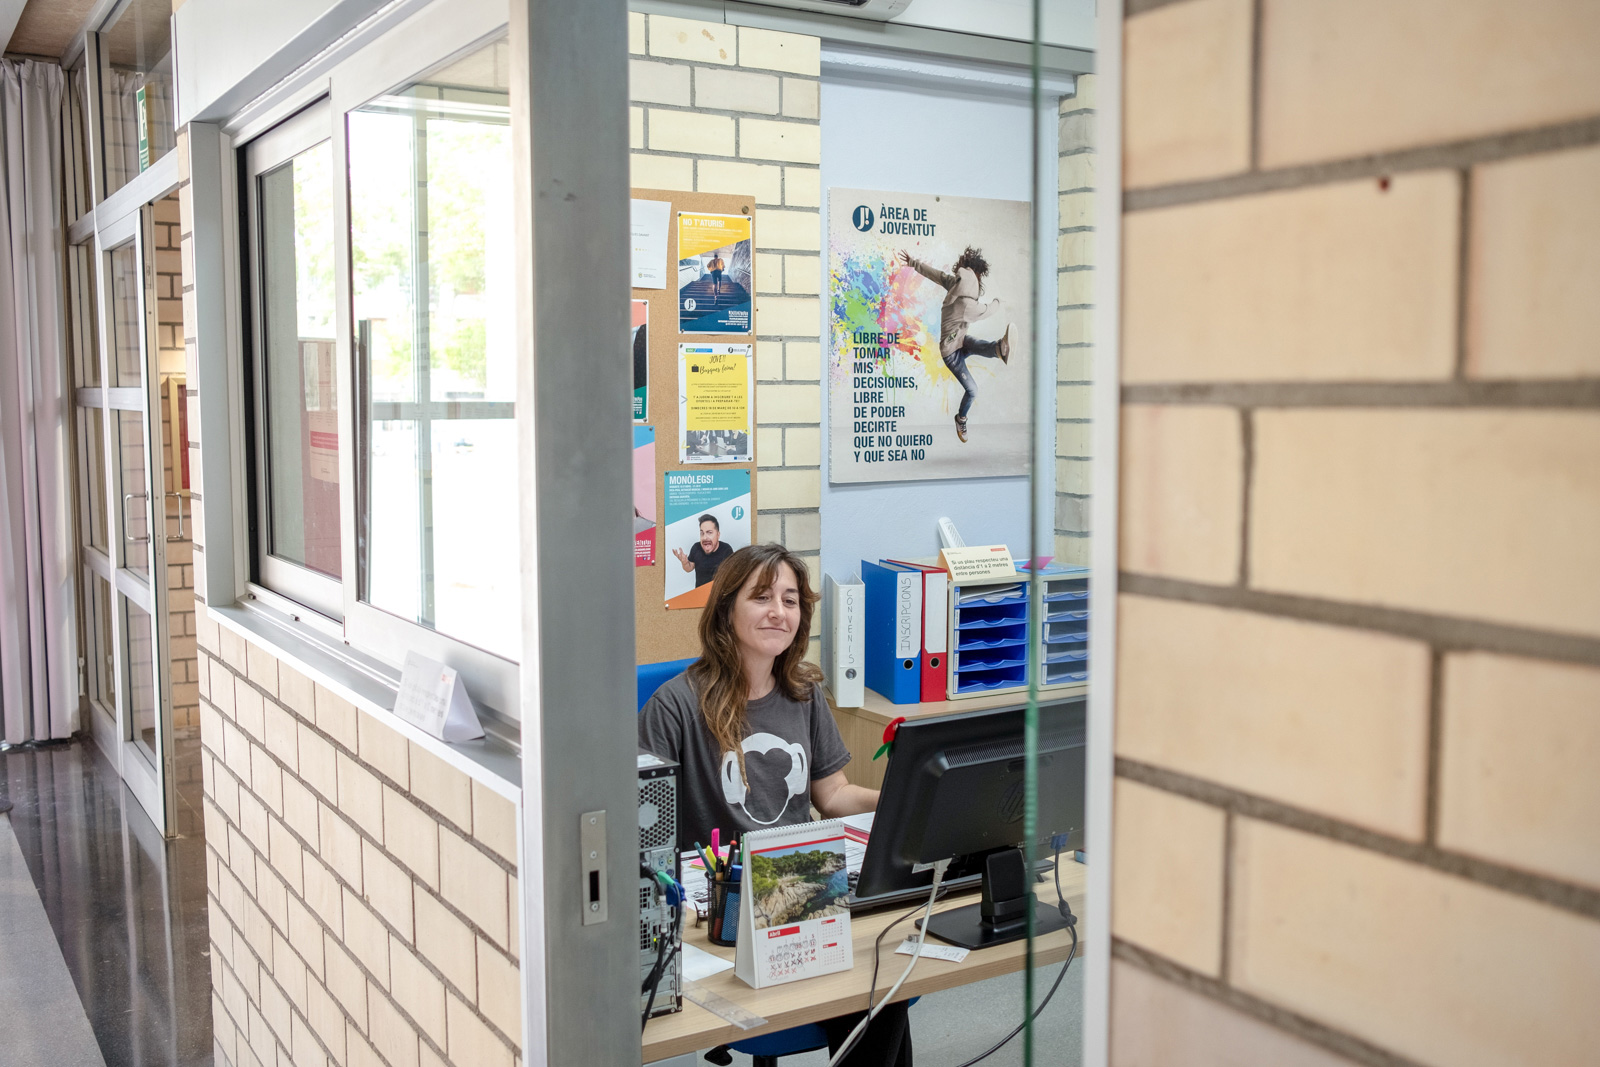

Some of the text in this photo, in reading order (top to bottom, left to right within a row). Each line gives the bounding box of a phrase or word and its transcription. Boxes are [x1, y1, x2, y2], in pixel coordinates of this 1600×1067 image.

[879, 203, 928, 222] ÀREA DE
[682, 218, 725, 228] NO T'ATURIS!
[879, 221, 936, 237] JOVENTUT
[853, 332, 900, 344] LIBRE DE
[853, 347, 891, 359] TOMAR
[853, 362, 874, 374] MIS
[853, 376, 918, 390] DECISIONES,
[853, 391, 884, 404] LIBRE
[853, 406, 905, 418] DE PODER
[853, 421, 897, 433] DECIRTE
[853, 434, 933, 449] QUE NO QUIERO
[853, 448, 925, 463] Y QUE SEA NO
[669, 474, 714, 485] MONÒLEGS!
[900, 577, 912, 651] INSCRIPCIONS
[846, 589, 855, 664] CONVENIS
